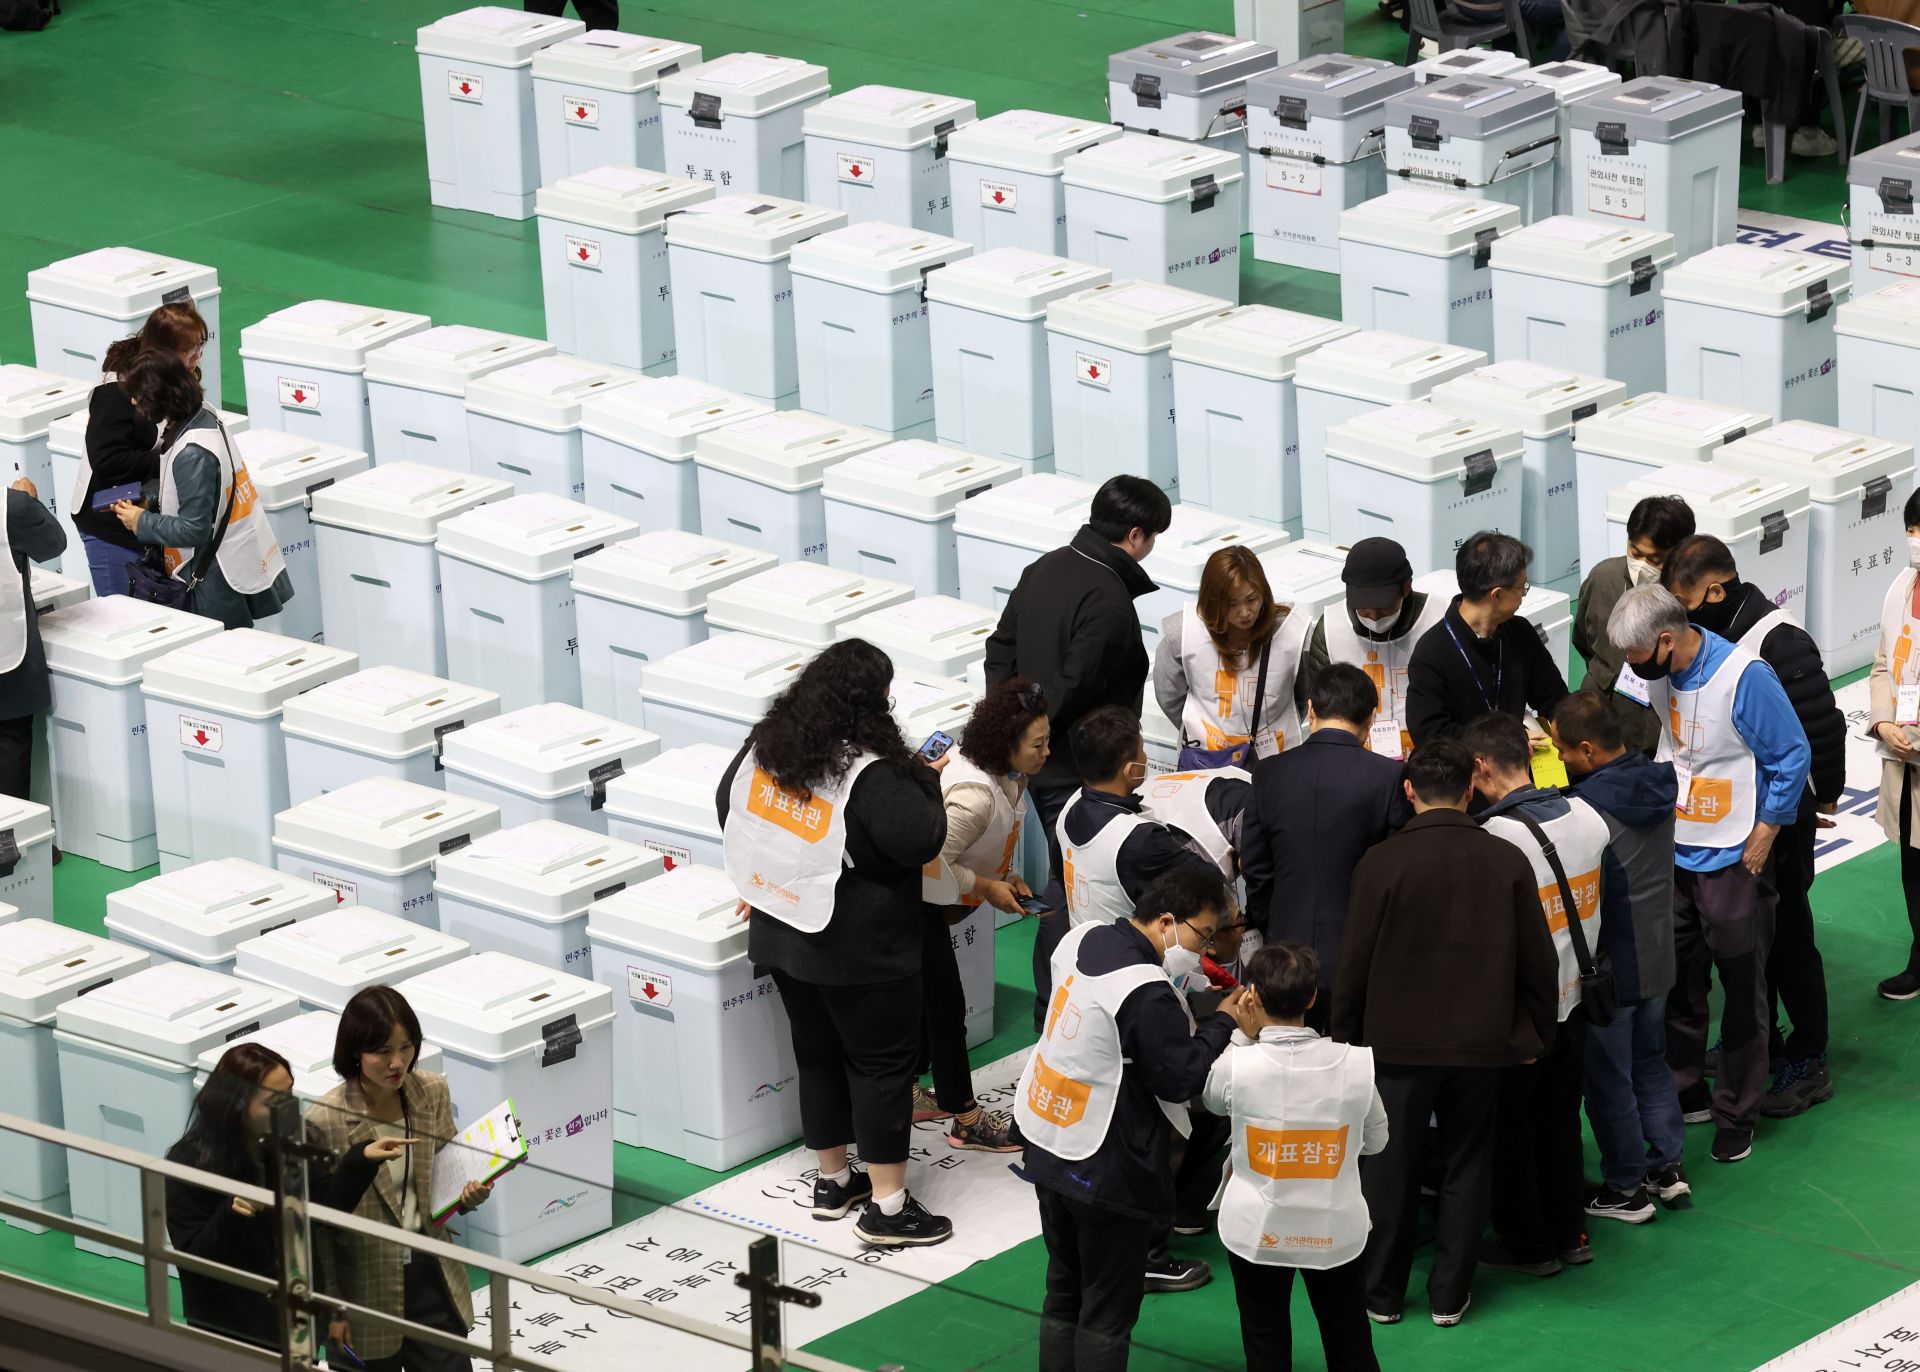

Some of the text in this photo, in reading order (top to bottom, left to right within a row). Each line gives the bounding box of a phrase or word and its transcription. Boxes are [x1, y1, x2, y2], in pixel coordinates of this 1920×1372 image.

[685, 164, 733, 185] 투표함
[1590, 169, 1644, 187] 관외사전 투표함
[927, 196, 950, 215] 투표
[1872, 225, 1920, 243] 관외사전 투표
[775, 289, 792, 302] 민주주
[282, 539, 310, 556] 민주주의
[804, 543, 825, 556] 민주주
[1851, 546, 1894, 576] 투표함
[131, 724, 146, 736] 민주
[758, 784, 822, 830] 개표참관
[403, 892, 433, 911] 민주주의
[722, 983, 774, 1011] 민주주의 꽃은
[545, 1127, 563, 1143] 꽃은
[566, 1108, 608, 1137] 선거입니다
[1257, 1141, 1340, 1165] 개표참관
[1284, 1235, 1333, 1245] 선거관리위원회
